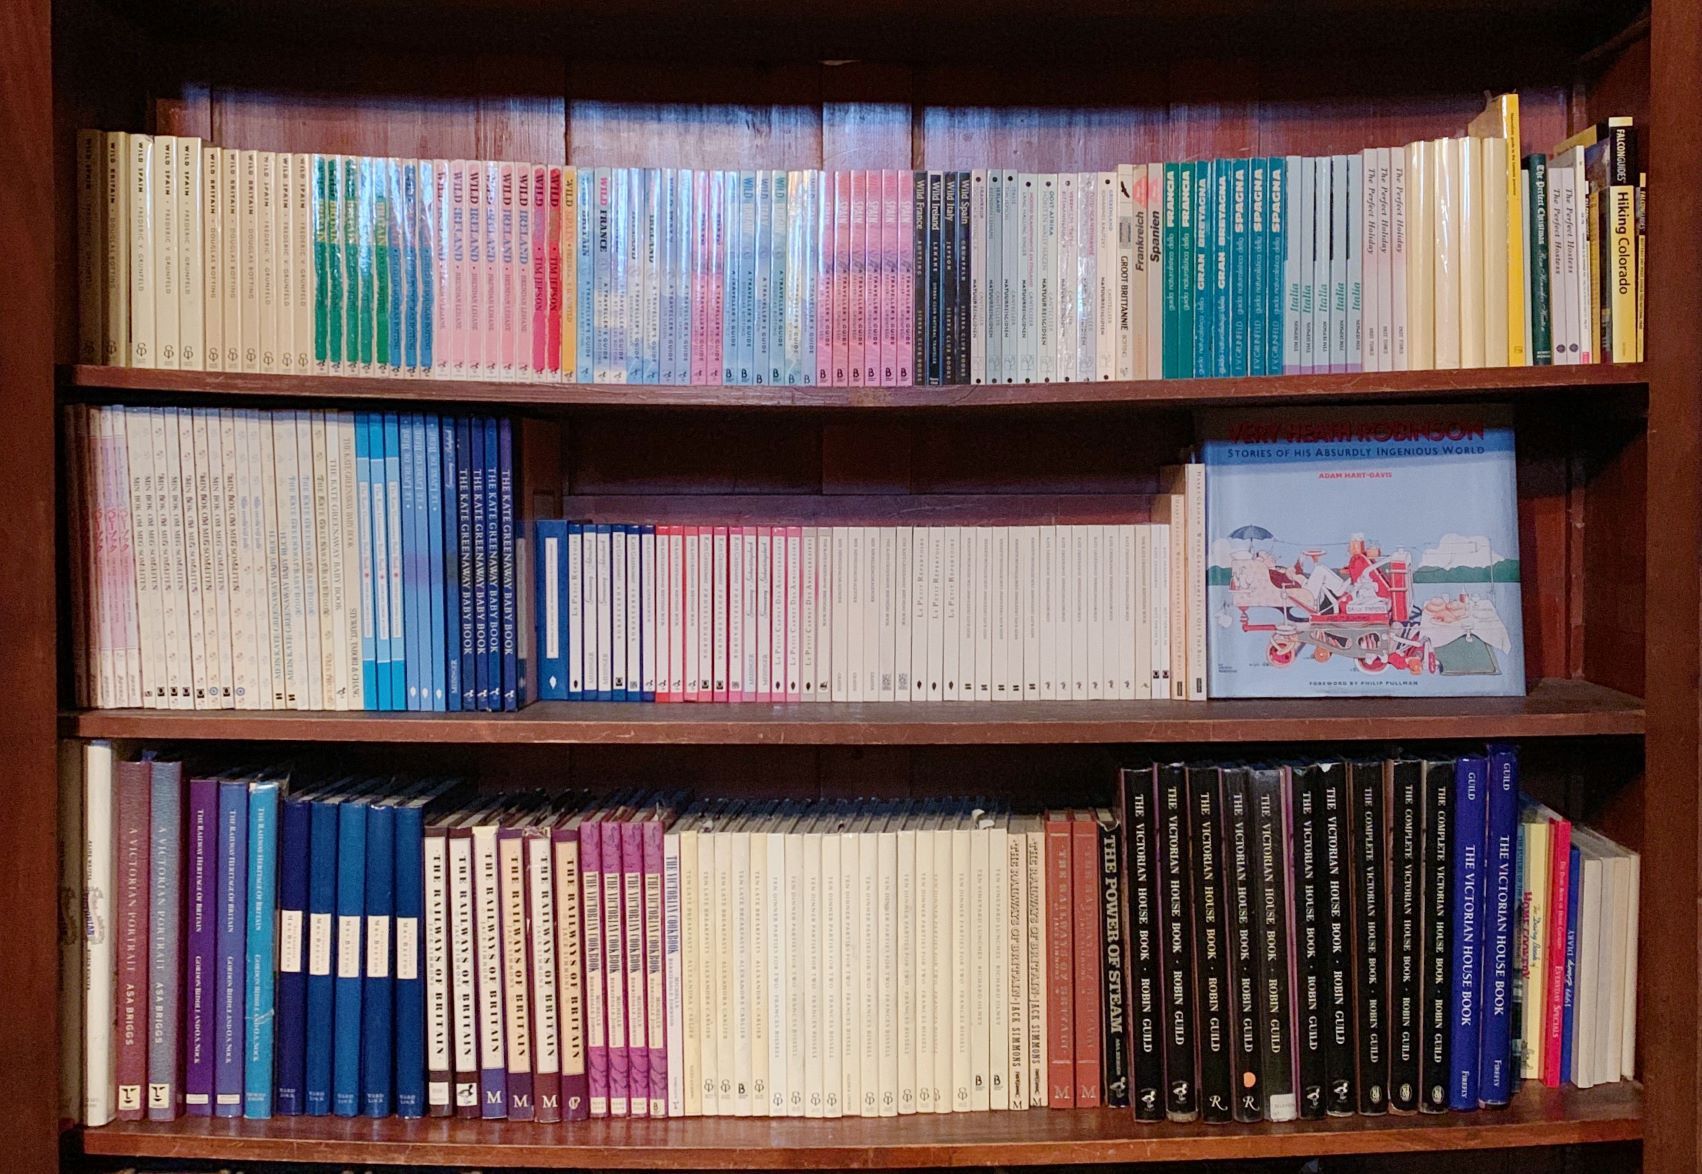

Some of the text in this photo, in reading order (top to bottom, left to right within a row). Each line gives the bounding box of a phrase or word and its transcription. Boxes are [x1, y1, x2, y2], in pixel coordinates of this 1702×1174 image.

[916, 180, 924, 229] Wild France
[932, 182, 940, 201] Wild
[944, 203, 954, 221] Italy
[960, 179, 969, 224] Wild Spain
[1181, 170, 1189, 227] FRANCIA
[1234, 169, 1244, 232] SPAGNA
[1253, 168, 1262, 232] SPAGNA
[1271, 169, 1281, 232] SPAGNA
[1135, 211, 1144, 271] Frankreich
[1150, 210, 1161, 262] Spanien
[1615, 192, 1630, 294] Hiking Colorado
[488, 468, 496, 488] THE
[1228, 445, 1485, 458] STORIES OF HIS ABSURDLY INGENIOUS WORLD
[488, 492, 496, 518] KATE
[489, 522, 497, 588] GREENAWAY
[502, 470, 512, 654] THE KATE GREENAWAY BABY BOOK
[489, 590, 497, 618] BABY
[1303, 821, 1312, 878] VICTORIAN
[1305, 885, 1313, 921] HOUSE
[1326, 787, 1344, 1044] THE VICTORIAN HOUSE BOOK ROBIN GUILD
[1436, 866, 1444, 915] VICTORIAN
[460, 891, 468, 963] RAILWAYS
[542, 891, 550, 963] RAILWAYS
[647, 876, 659, 973] THE VICTORIAN COOKBOOK
[1104, 835, 1122, 1032] THE POWER OF STEAM
[1135, 794, 1151, 1052] THE VICTORIAN HOUSE BOOK ROBIN GUILD
[1200, 793, 1219, 1051] THE VICTORIAN HOUSE BOOK ROBIN GUILD
[1306, 928, 1314, 957] BOOK
[1461, 845, 1474, 1025] THE VICTORIAN HOUSE BOOK
[1494, 835, 1508, 1014] THE VICTORIAN HOUSE BOOK
[125, 984, 134, 1004] ASA
[435, 968, 441, 984] OF
[462, 970, 468, 986] OF
[544, 970, 551, 986] OF
[1308, 976, 1316, 1009] ROBIN
[125, 1007, 133, 1045] BRIGGS
[462, 994, 470, 1055] BRITAIN
[545, 994, 553, 1055] BRITAIN
[1308, 1016, 1316, 1049] GUILD
